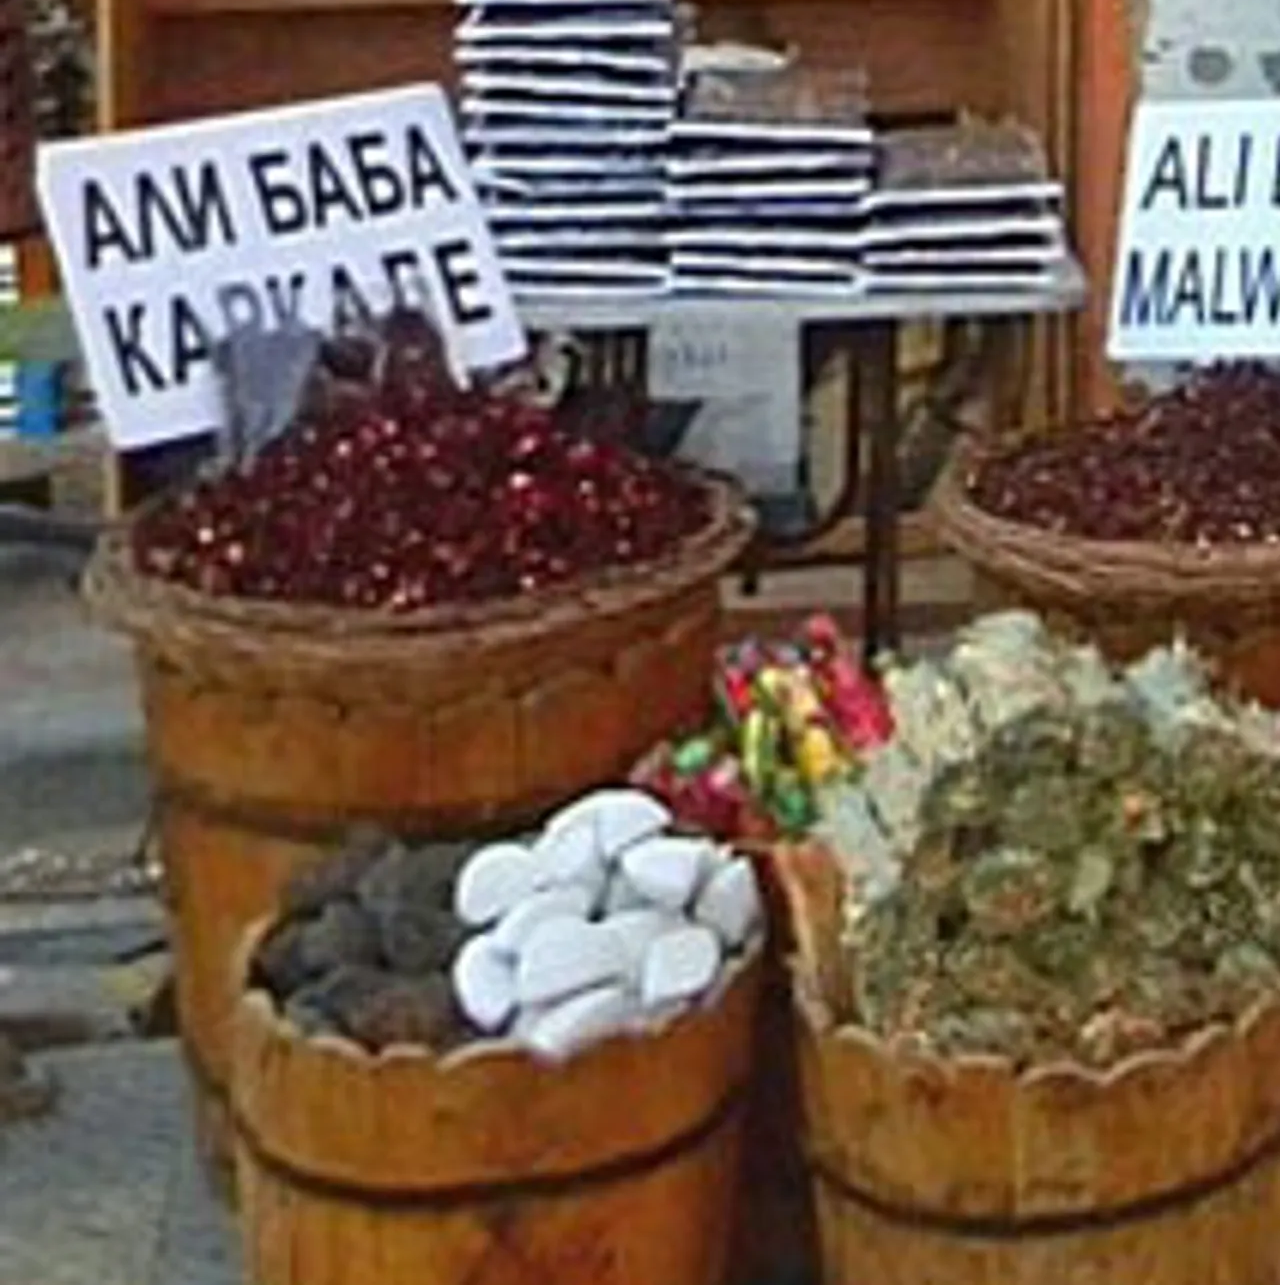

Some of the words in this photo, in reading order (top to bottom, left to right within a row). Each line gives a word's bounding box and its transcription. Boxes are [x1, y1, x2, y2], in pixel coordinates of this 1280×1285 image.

[83, 159, 237, 271] АЛИ
[248, 124, 459, 236] БАБА
[1140, 129, 1253, 211] ALI
